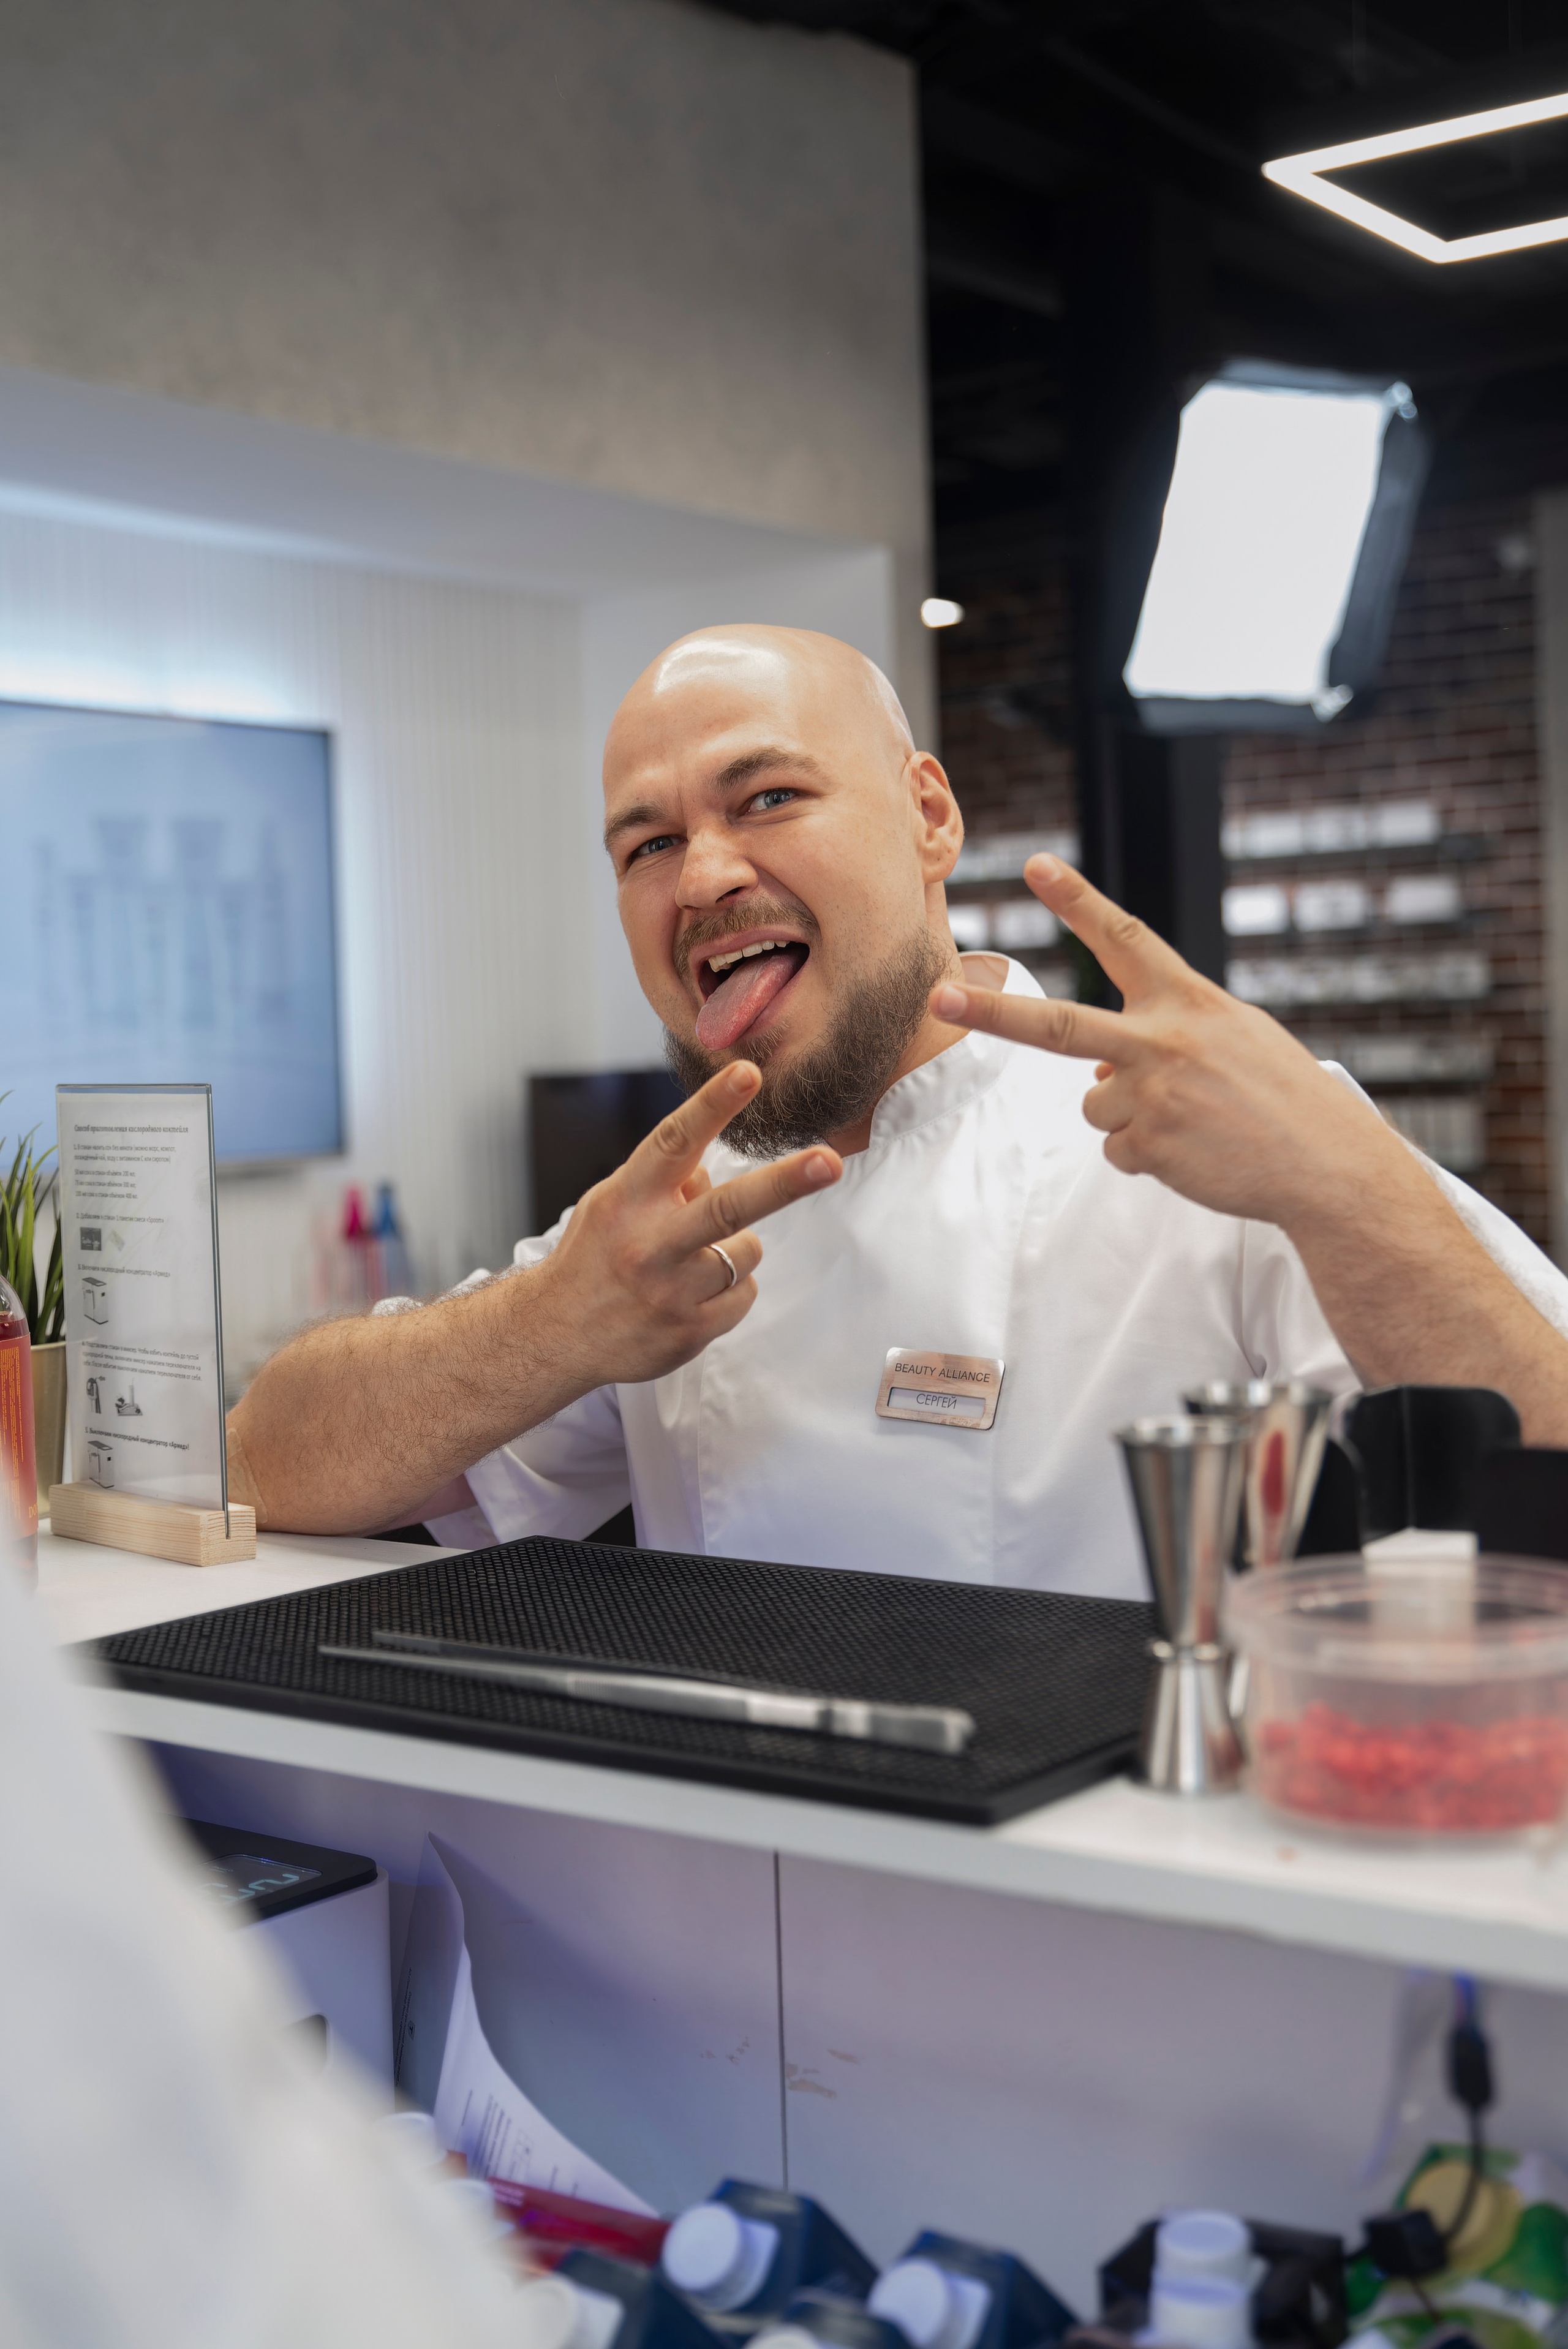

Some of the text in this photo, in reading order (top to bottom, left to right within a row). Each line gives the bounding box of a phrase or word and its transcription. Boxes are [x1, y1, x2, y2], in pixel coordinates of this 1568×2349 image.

[90, 1125, 127, 1134] приготовления
[128, 1125, 161, 1134] кислородного
[165, 1362, 195, 1371] переключателя
[895, 1363, 991, 1382] BEAUTY ALLIANCE
[157, 1371, 186, 1379] переключателя
[916, 1393, 957, 1409] СЕРГЕЙ
[112, 1433, 139, 1441] кислородный
[140, 1438, 168, 1447] концентратор
[169, 1441, 189, 1450] «Армед»!
